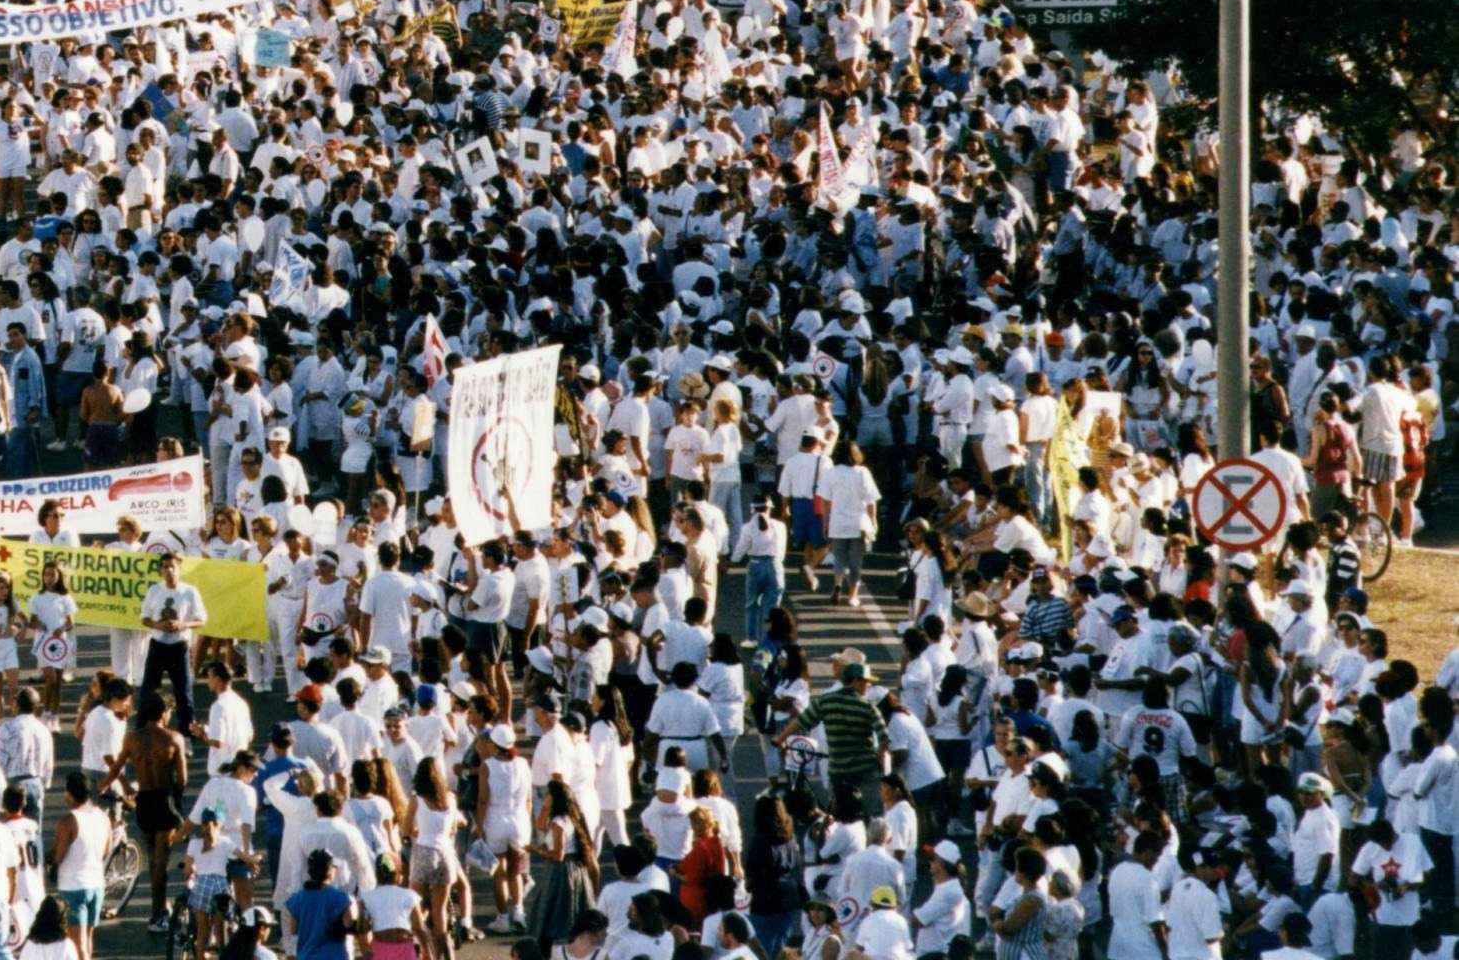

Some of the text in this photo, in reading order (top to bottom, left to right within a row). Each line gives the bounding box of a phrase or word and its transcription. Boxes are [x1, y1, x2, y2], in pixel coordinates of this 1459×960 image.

[40, 474, 112, 495] CRUZEIRO
[56, 495, 96, 510] ELA
[23, 568, 153, 602] SURANÇ
